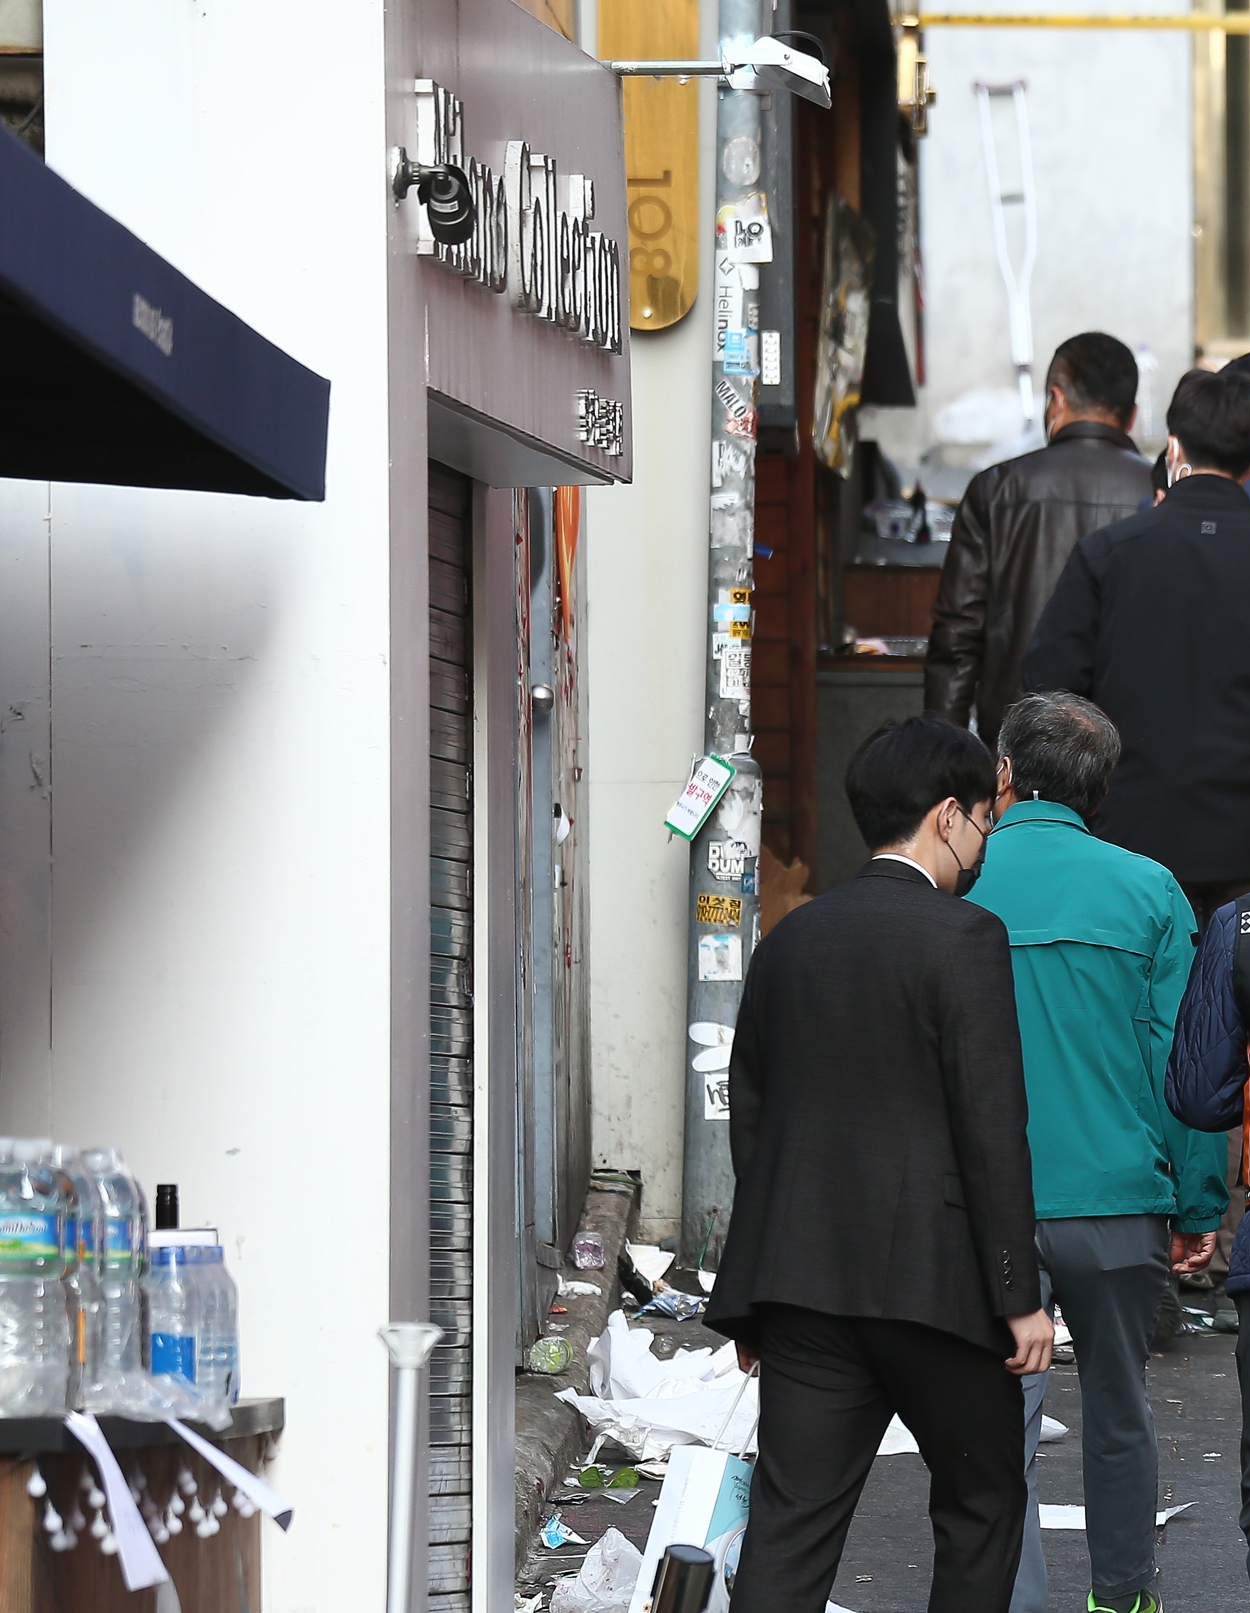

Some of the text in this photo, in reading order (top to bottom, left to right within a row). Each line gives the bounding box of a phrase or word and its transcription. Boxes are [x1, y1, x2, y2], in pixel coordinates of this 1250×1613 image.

[415, 79, 623, 355] Mlano Collection
[717, 285, 734, 354] Helinox
[716, 380, 747, 419] MALO
[708, 859, 745, 874] DUM
